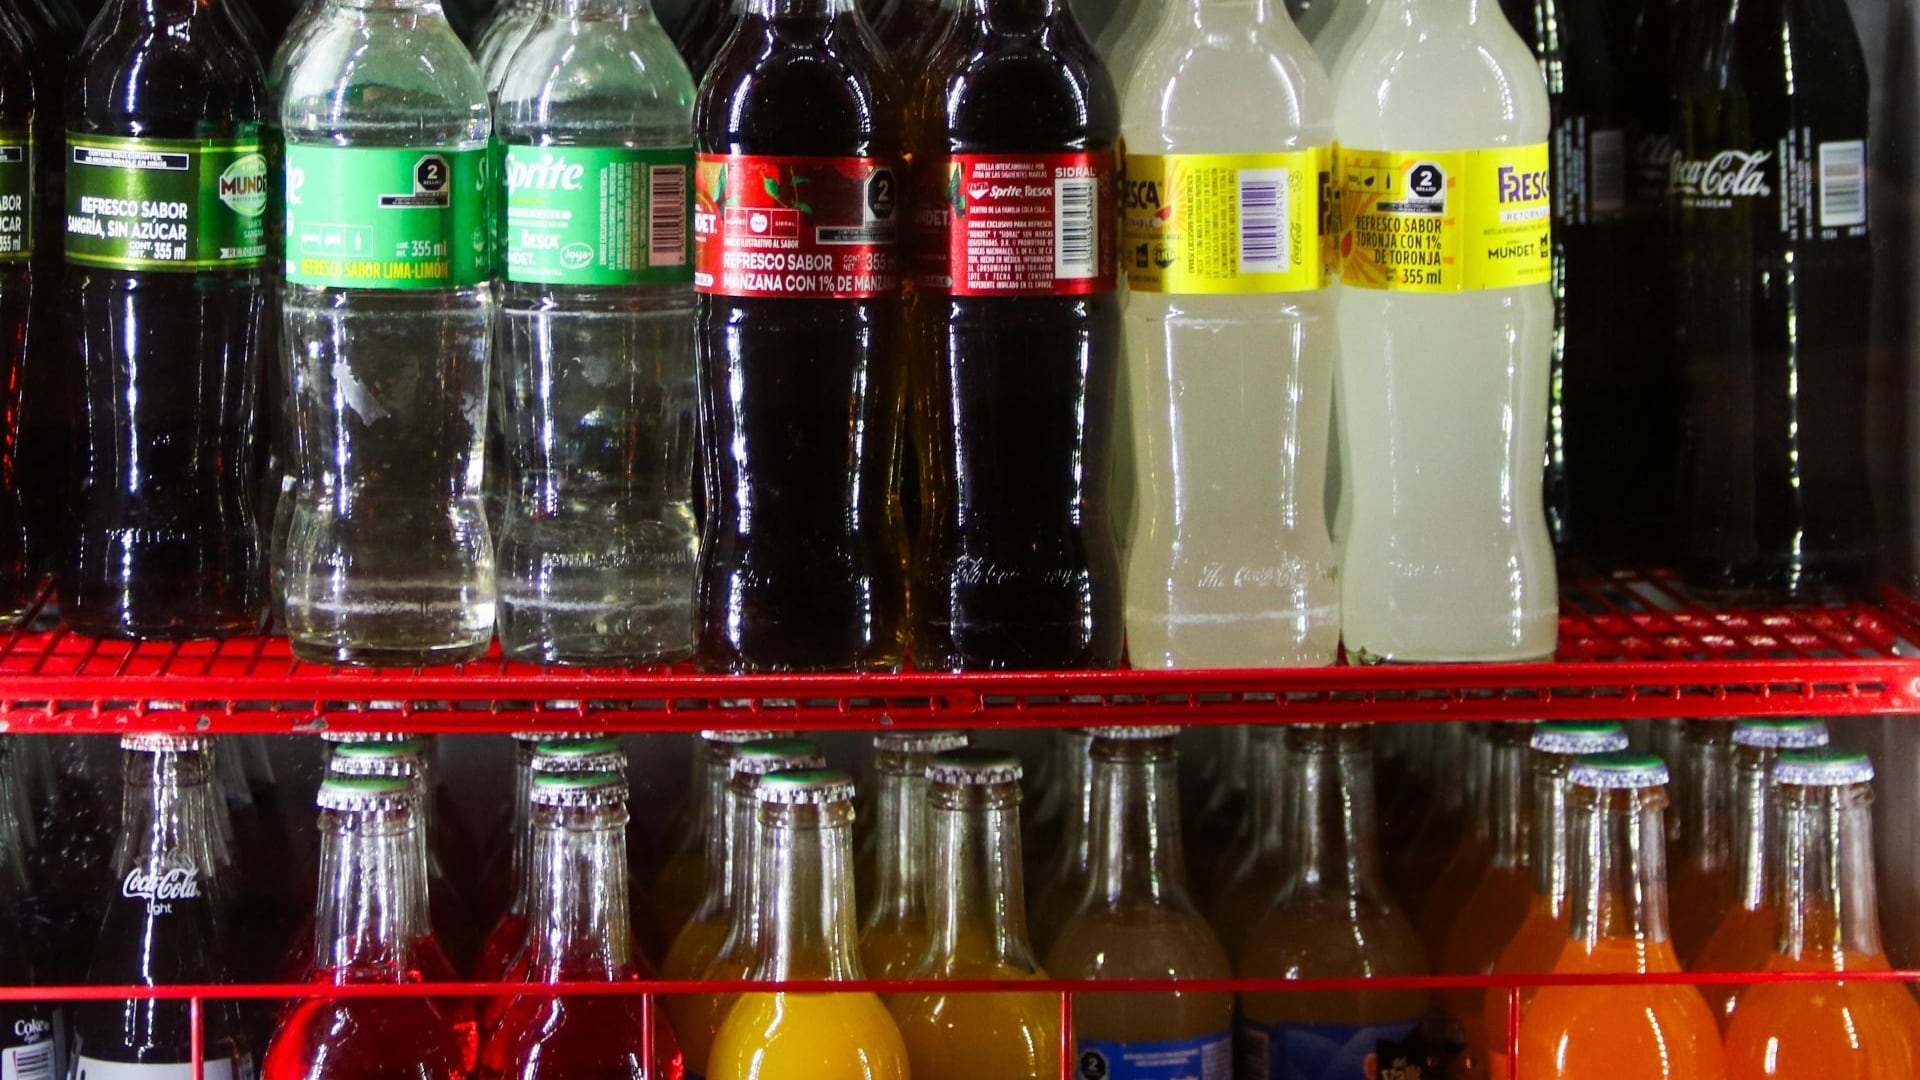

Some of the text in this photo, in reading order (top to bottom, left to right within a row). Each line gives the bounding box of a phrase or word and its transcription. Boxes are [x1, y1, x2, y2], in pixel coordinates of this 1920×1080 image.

[427, 164, 438, 179] 2
[505, 152, 585, 196] Sprite
[1055, 167, 1096, 178] SIDRAL
[1420, 170, 1433, 187] 2
[878, 180, 889, 201] 2
[989, 185, 1022, 199] Sprite
[1025, 185, 1052, 197] FRESCA
[1498, 166, 1549, 203] FRESC
[81, 196, 188, 219] REFRESCO SABOR
[68, 214, 187, 240] SANGRÍA, SIN AZÚCAR
[1356, 216, 1441, 233] REFRESCO SABOR
[411, 241, 430, 256] 355
[434, 240, 447, 256] ml
[1356, 232, 1441, 250] TORONJA CON 1%
[153, 241, 186, 260] 355 ml
[1375, 249, 1441, 266] DE TORONJA
[302, 258, 342, 277] REFRESCO
[345, 261, 380, 279] SABOR
[384, 259, 449, 279] LIMA-LIMÓN
[724, 251, 832, 271] REFRESCO SABOR
[866, 253, 886, 271] 355
[977, 264, 1011, 272] CONSUMIDOR
[724, 272, 782, 291] MANZANA
[786, 274, 815, 291] CON
[819, 274, 835, 292] 1%
[838, 275, 852, 291] DE
[1402, 269, 1423, 284] 355
[1427, 269, 1441, 285] ml
[123, 867, 200, 899] Coca-Cola
[15, 1019, 45, 1037] Coke
